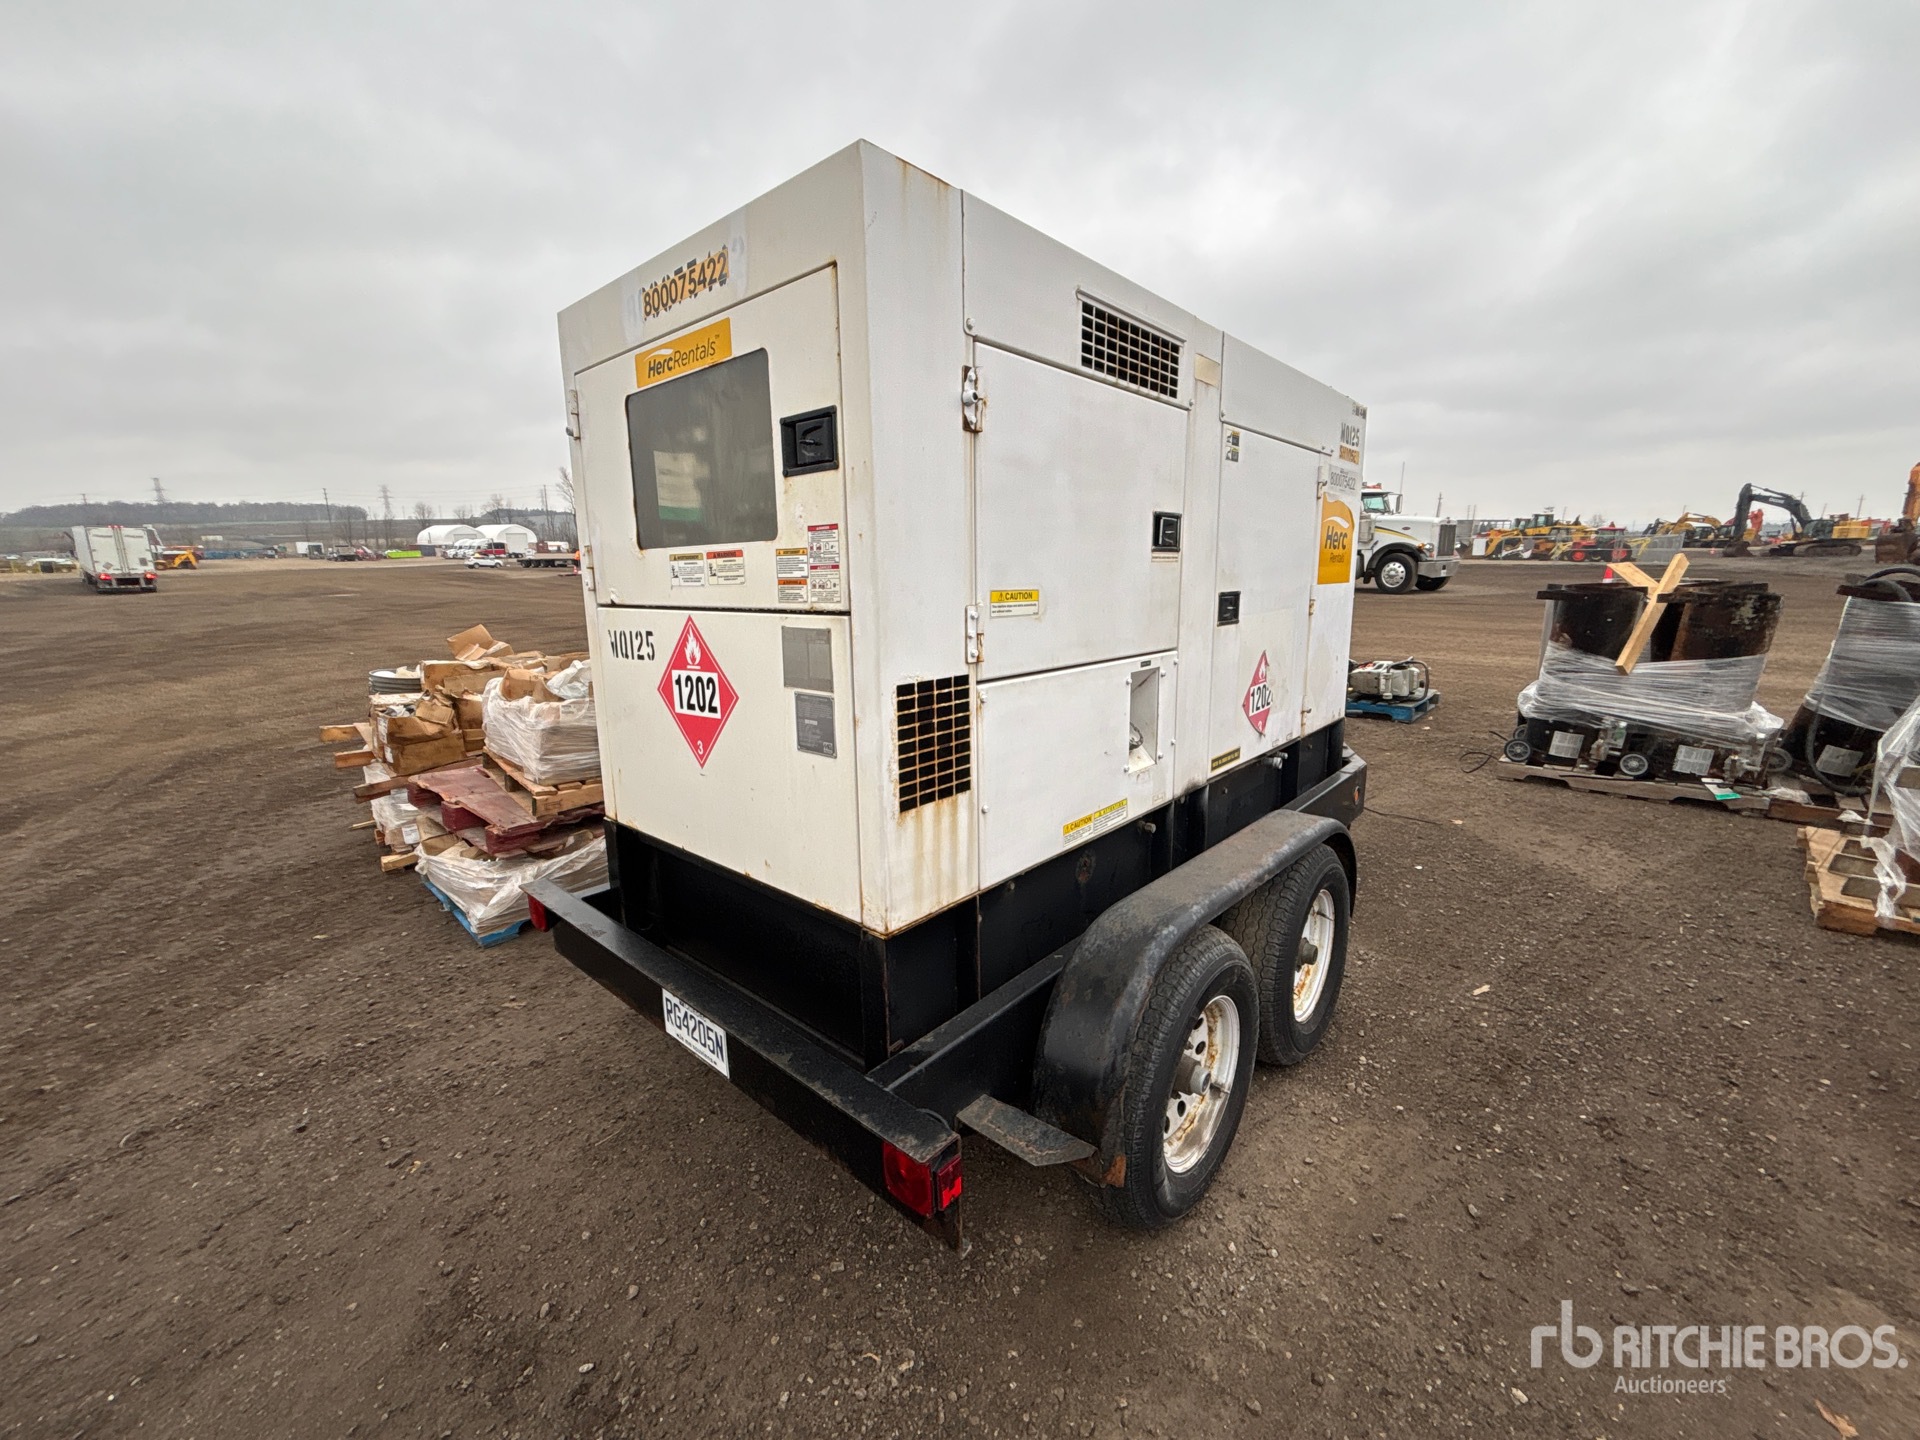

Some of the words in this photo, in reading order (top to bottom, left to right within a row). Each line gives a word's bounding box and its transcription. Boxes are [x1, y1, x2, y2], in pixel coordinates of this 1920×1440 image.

[643, 250, 728, 318] 800075422
[1324, 526, 1348, 550] Herc
[1005, 592, 1033, 601] CAUTION
[674, 674, 719, 714] 1202
[697, 739, 704, 755] 3
[1070, 815, 1092, 831] CAUTION
[665, 997, 725, 1062] RG4205N
